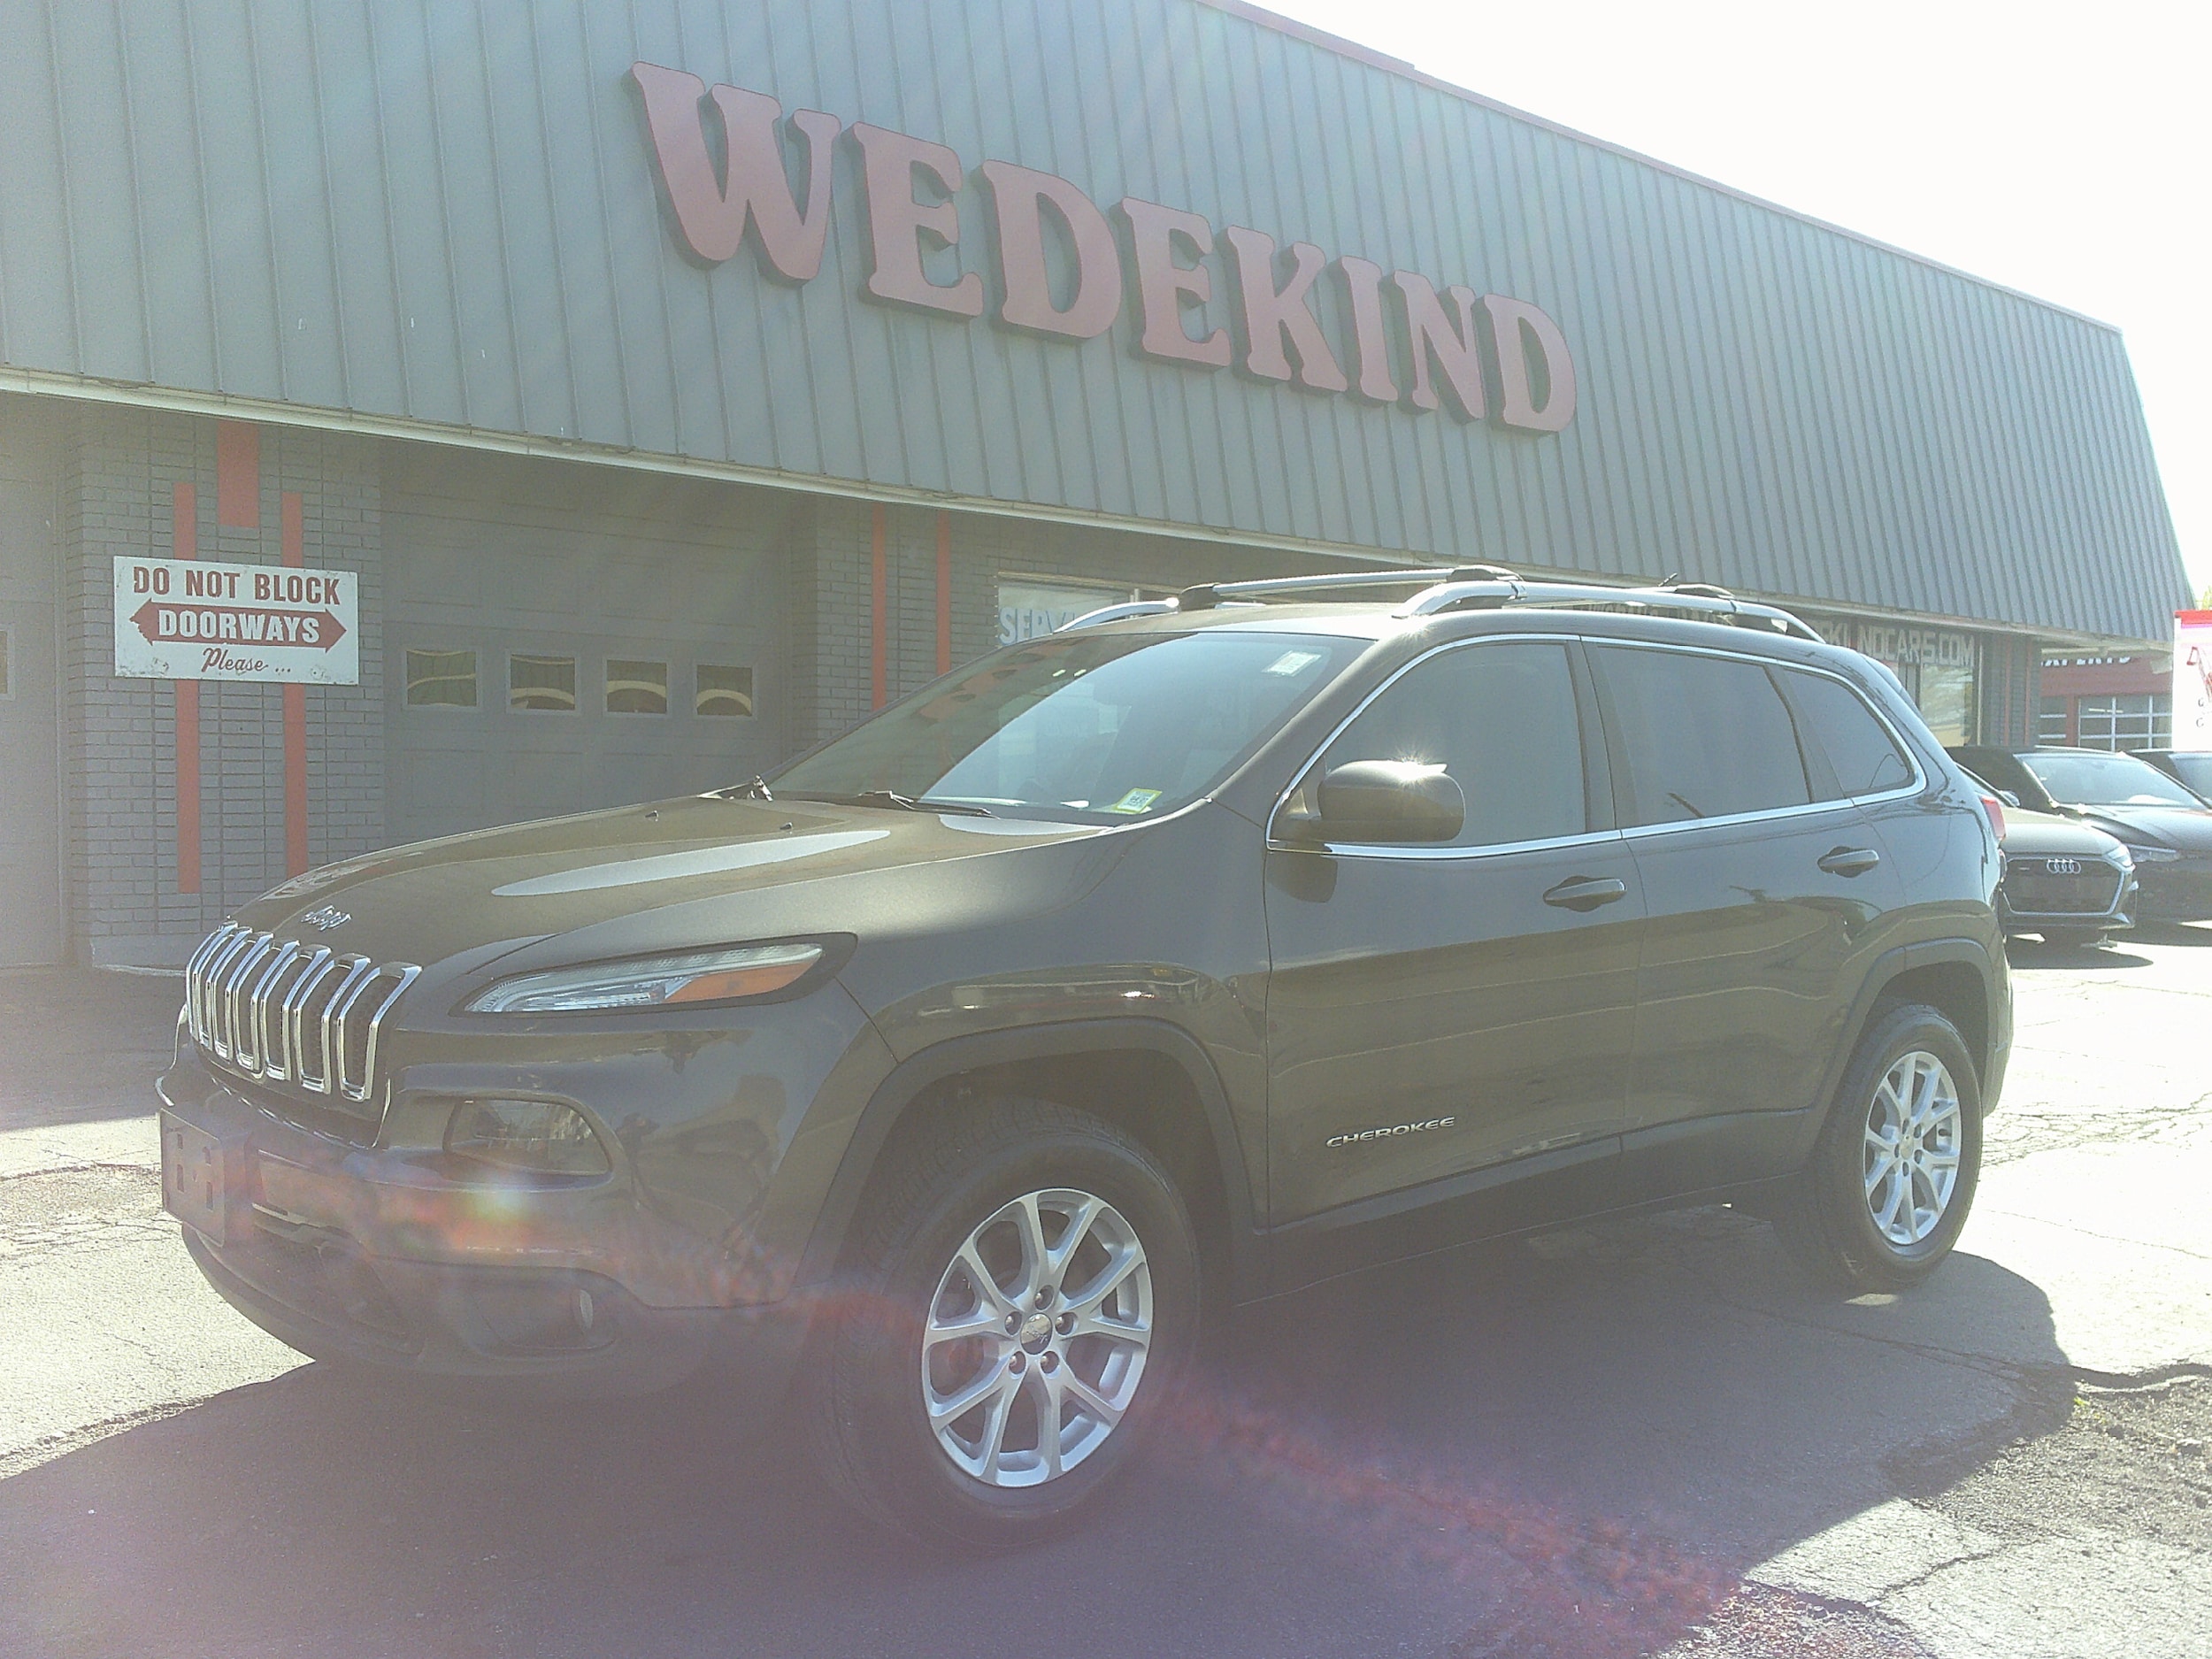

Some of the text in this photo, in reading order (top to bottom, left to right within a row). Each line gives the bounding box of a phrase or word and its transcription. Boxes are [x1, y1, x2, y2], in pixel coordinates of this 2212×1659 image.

[630, 60, 1578, 435] WEDEKIND
[134, 566, 341, 605] DO NOT BLOCK
[158, 610, 319, 642] DOORWAYS
[201, 647, 269, 672] Please
[1325, 1116, 1456, 1148] CHEROKEE
